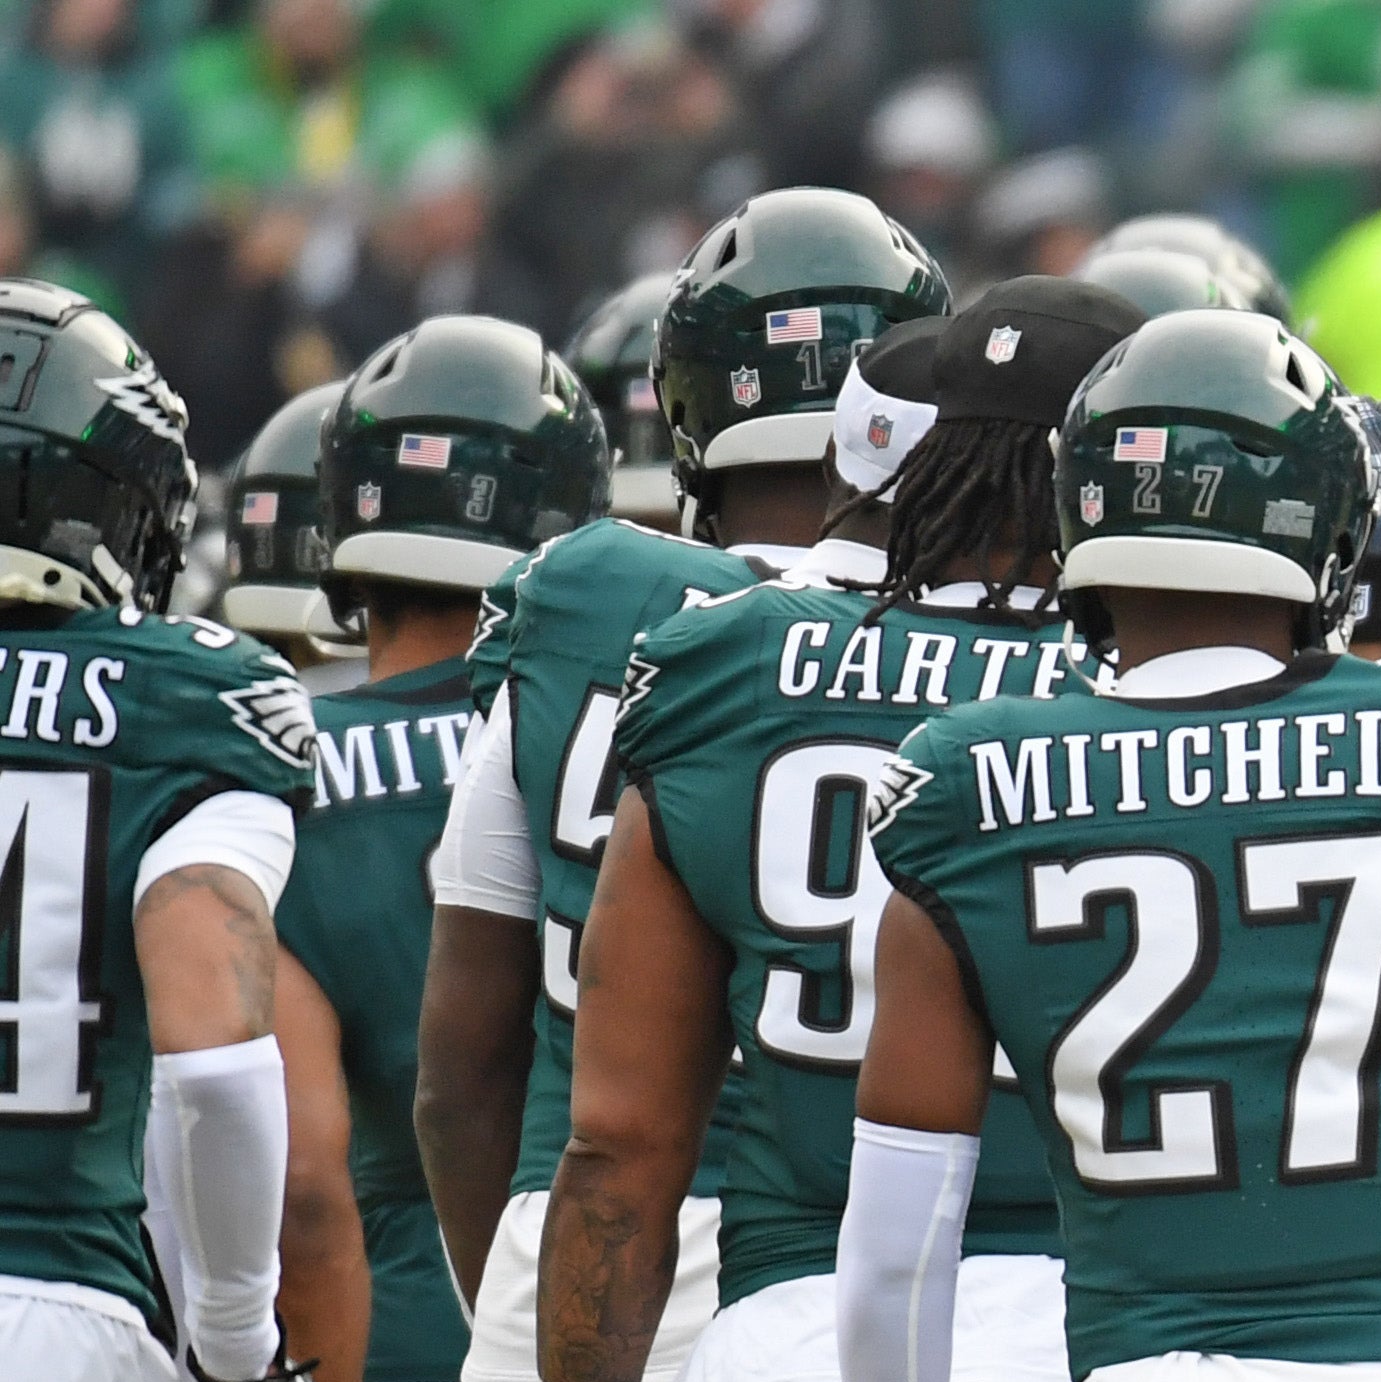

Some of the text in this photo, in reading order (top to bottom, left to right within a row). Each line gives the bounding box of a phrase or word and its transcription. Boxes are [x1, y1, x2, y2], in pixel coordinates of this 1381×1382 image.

[736, 384, 757, 399] NFL
[1132, 462, 1224, 518] 27
[0, 648, 125, 747] RS
[779, 621, 1118, 704] CARTE
[314, 712, 470, 808] MIT
[755, 740, 882, 1065] 9
